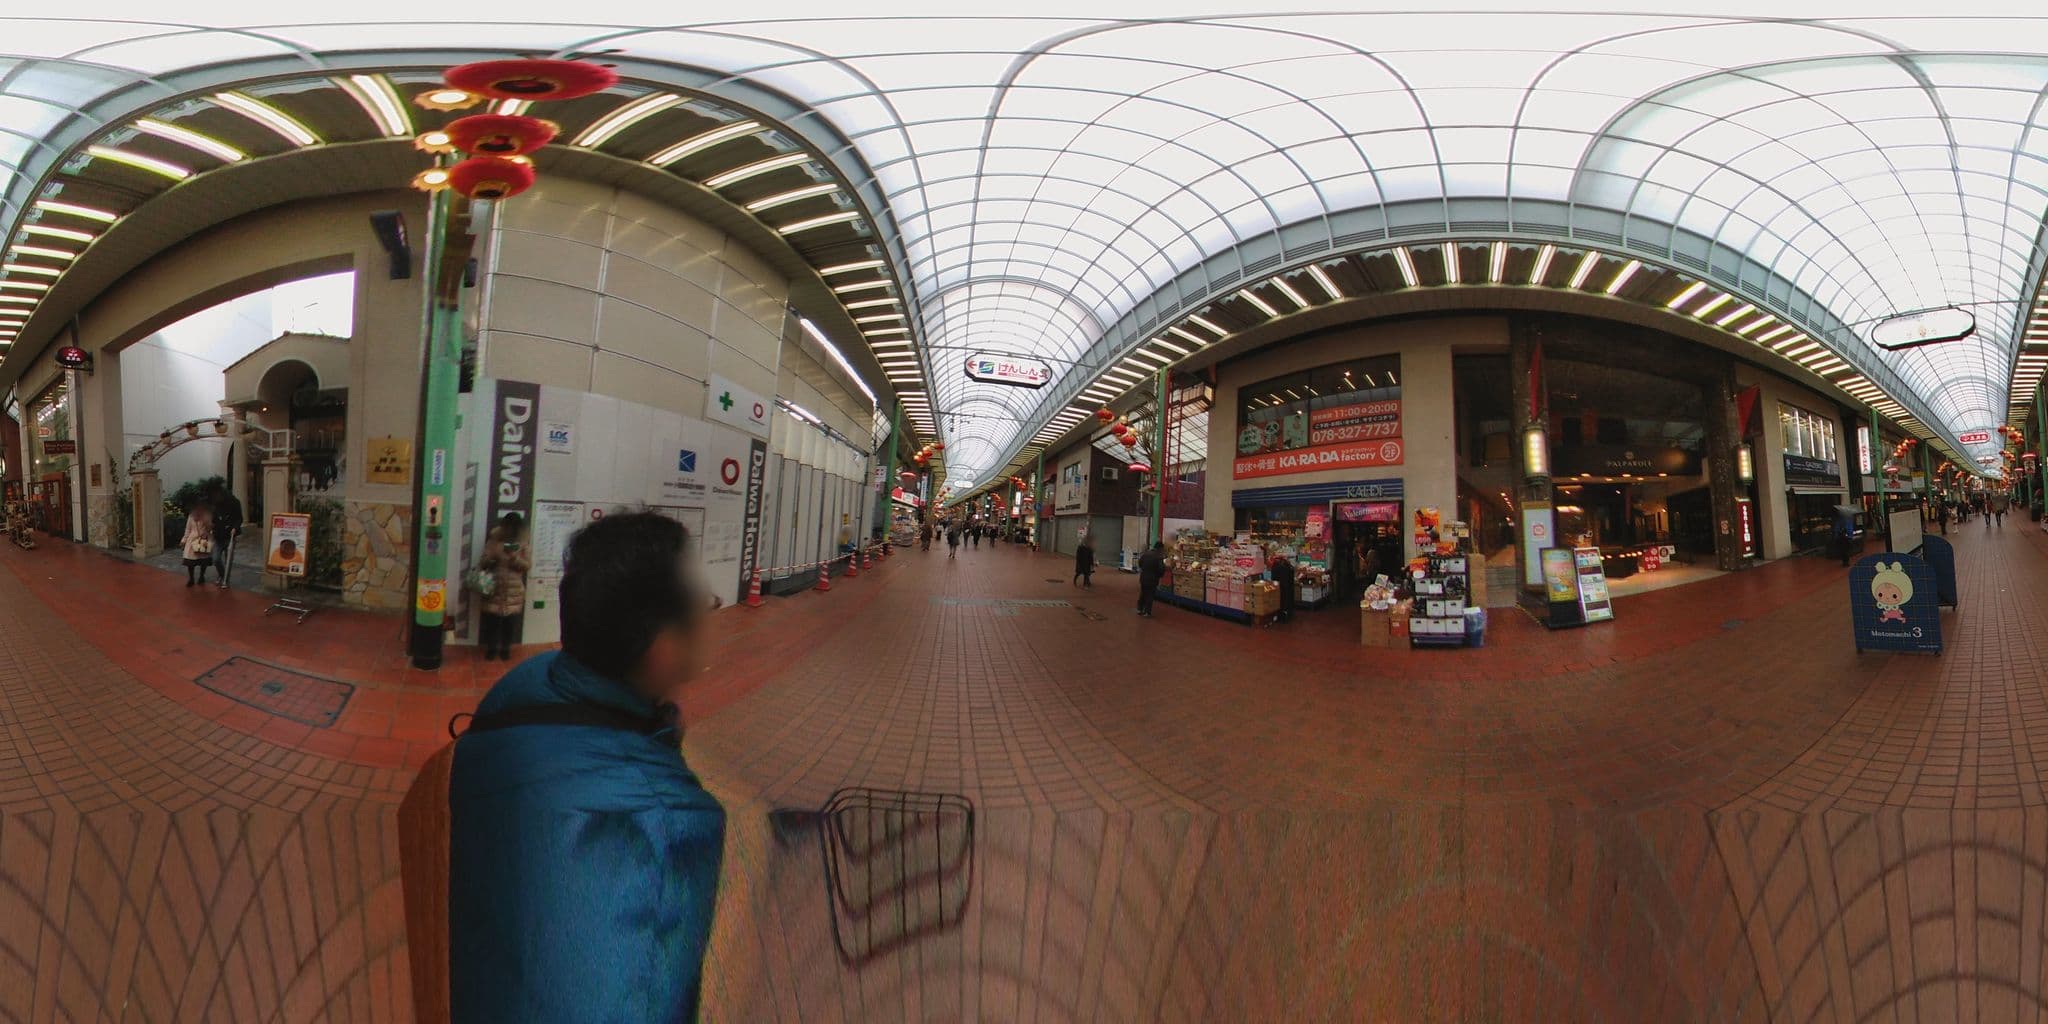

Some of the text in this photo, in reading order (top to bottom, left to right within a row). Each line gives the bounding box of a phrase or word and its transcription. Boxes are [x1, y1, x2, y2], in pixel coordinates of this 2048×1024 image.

[999, 363, 1039, 376] けんしん
[1334, 407, 1360, 417] 11:00
[1368, 403, 1398, 413] 20:00
[1312, 422, 1399, 442] 078-327-7737
[497, 397, 532, 503] Daiwa
[1341, 451, 1376, 462] factory
[1347, 485, 1384, 498] KALDI
[742, 450, 764, 582] Daiwa House
[1871, 626, 1922, 638] Motomachi 3
